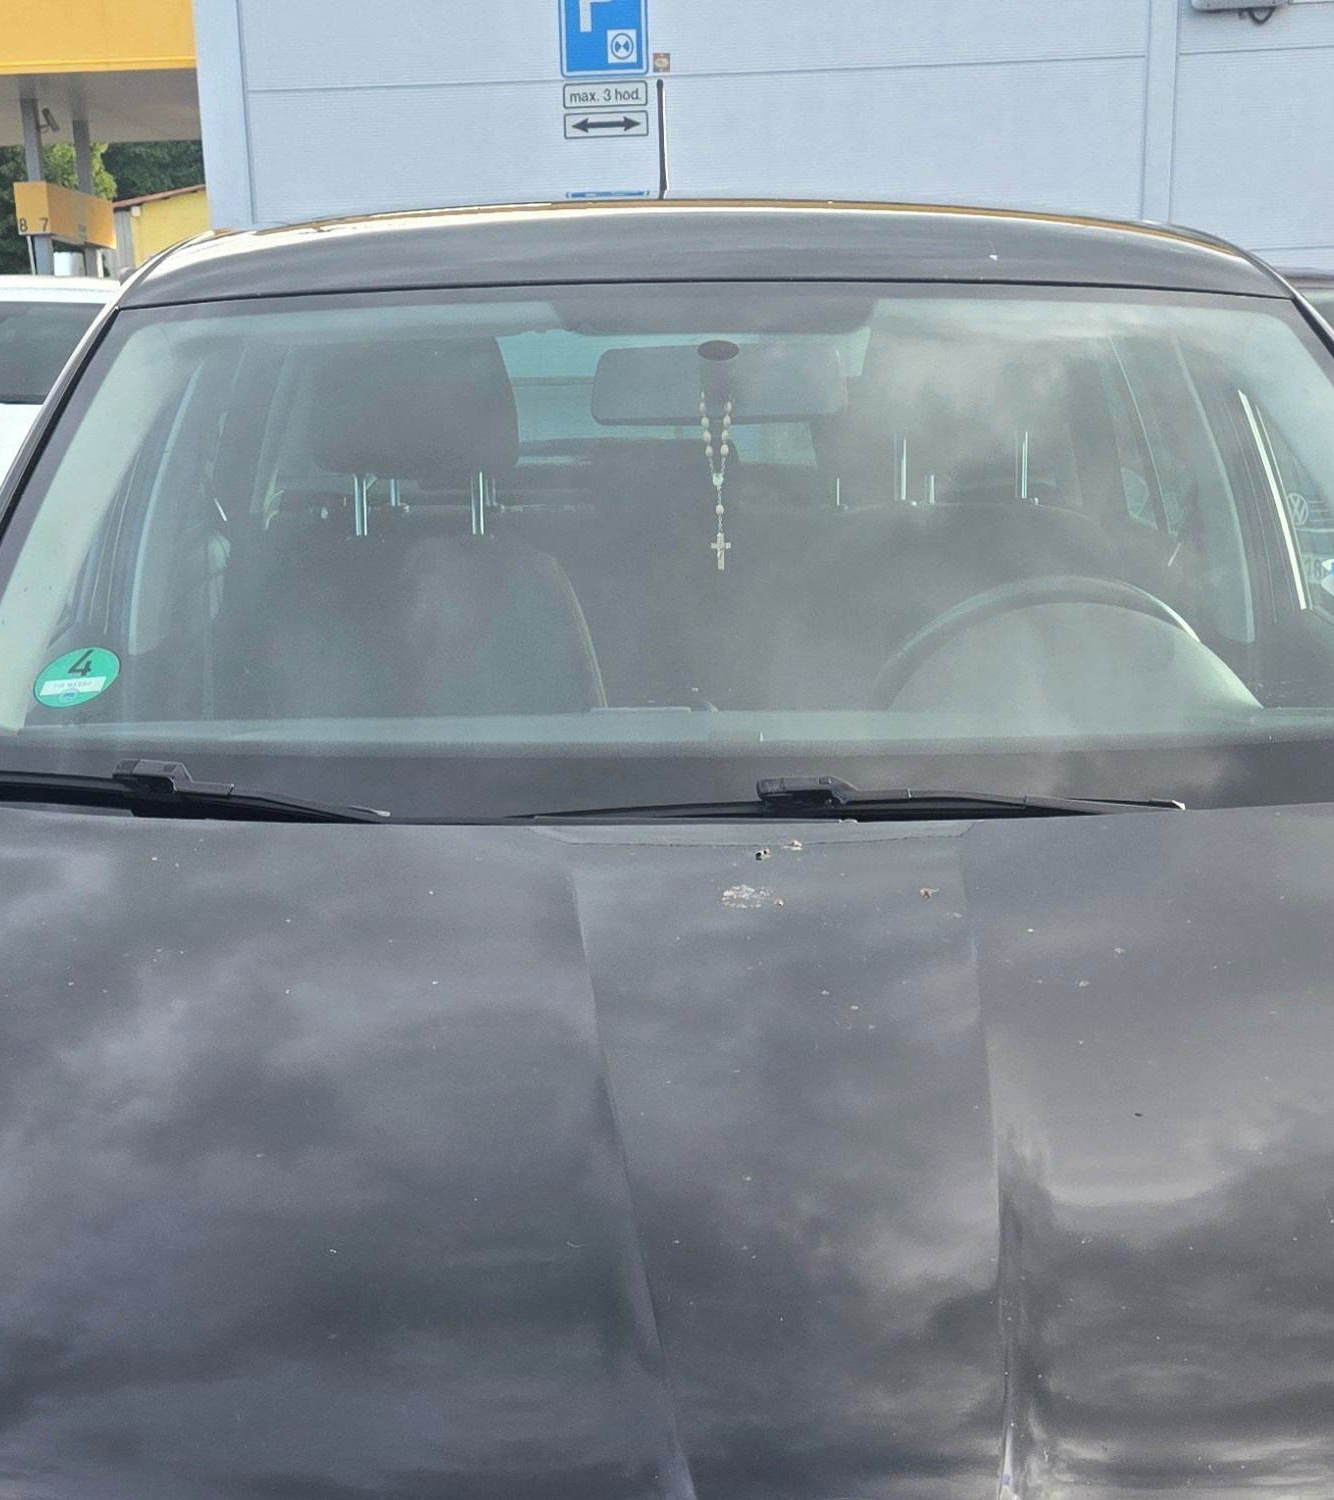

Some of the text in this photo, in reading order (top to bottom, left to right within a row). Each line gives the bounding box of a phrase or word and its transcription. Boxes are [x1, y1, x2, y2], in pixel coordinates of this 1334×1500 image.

[570, 87, 642, 103] max. 3 hod.
[19, 217, 49, 232] 8 7
[68, 649, 94, 676] 4
